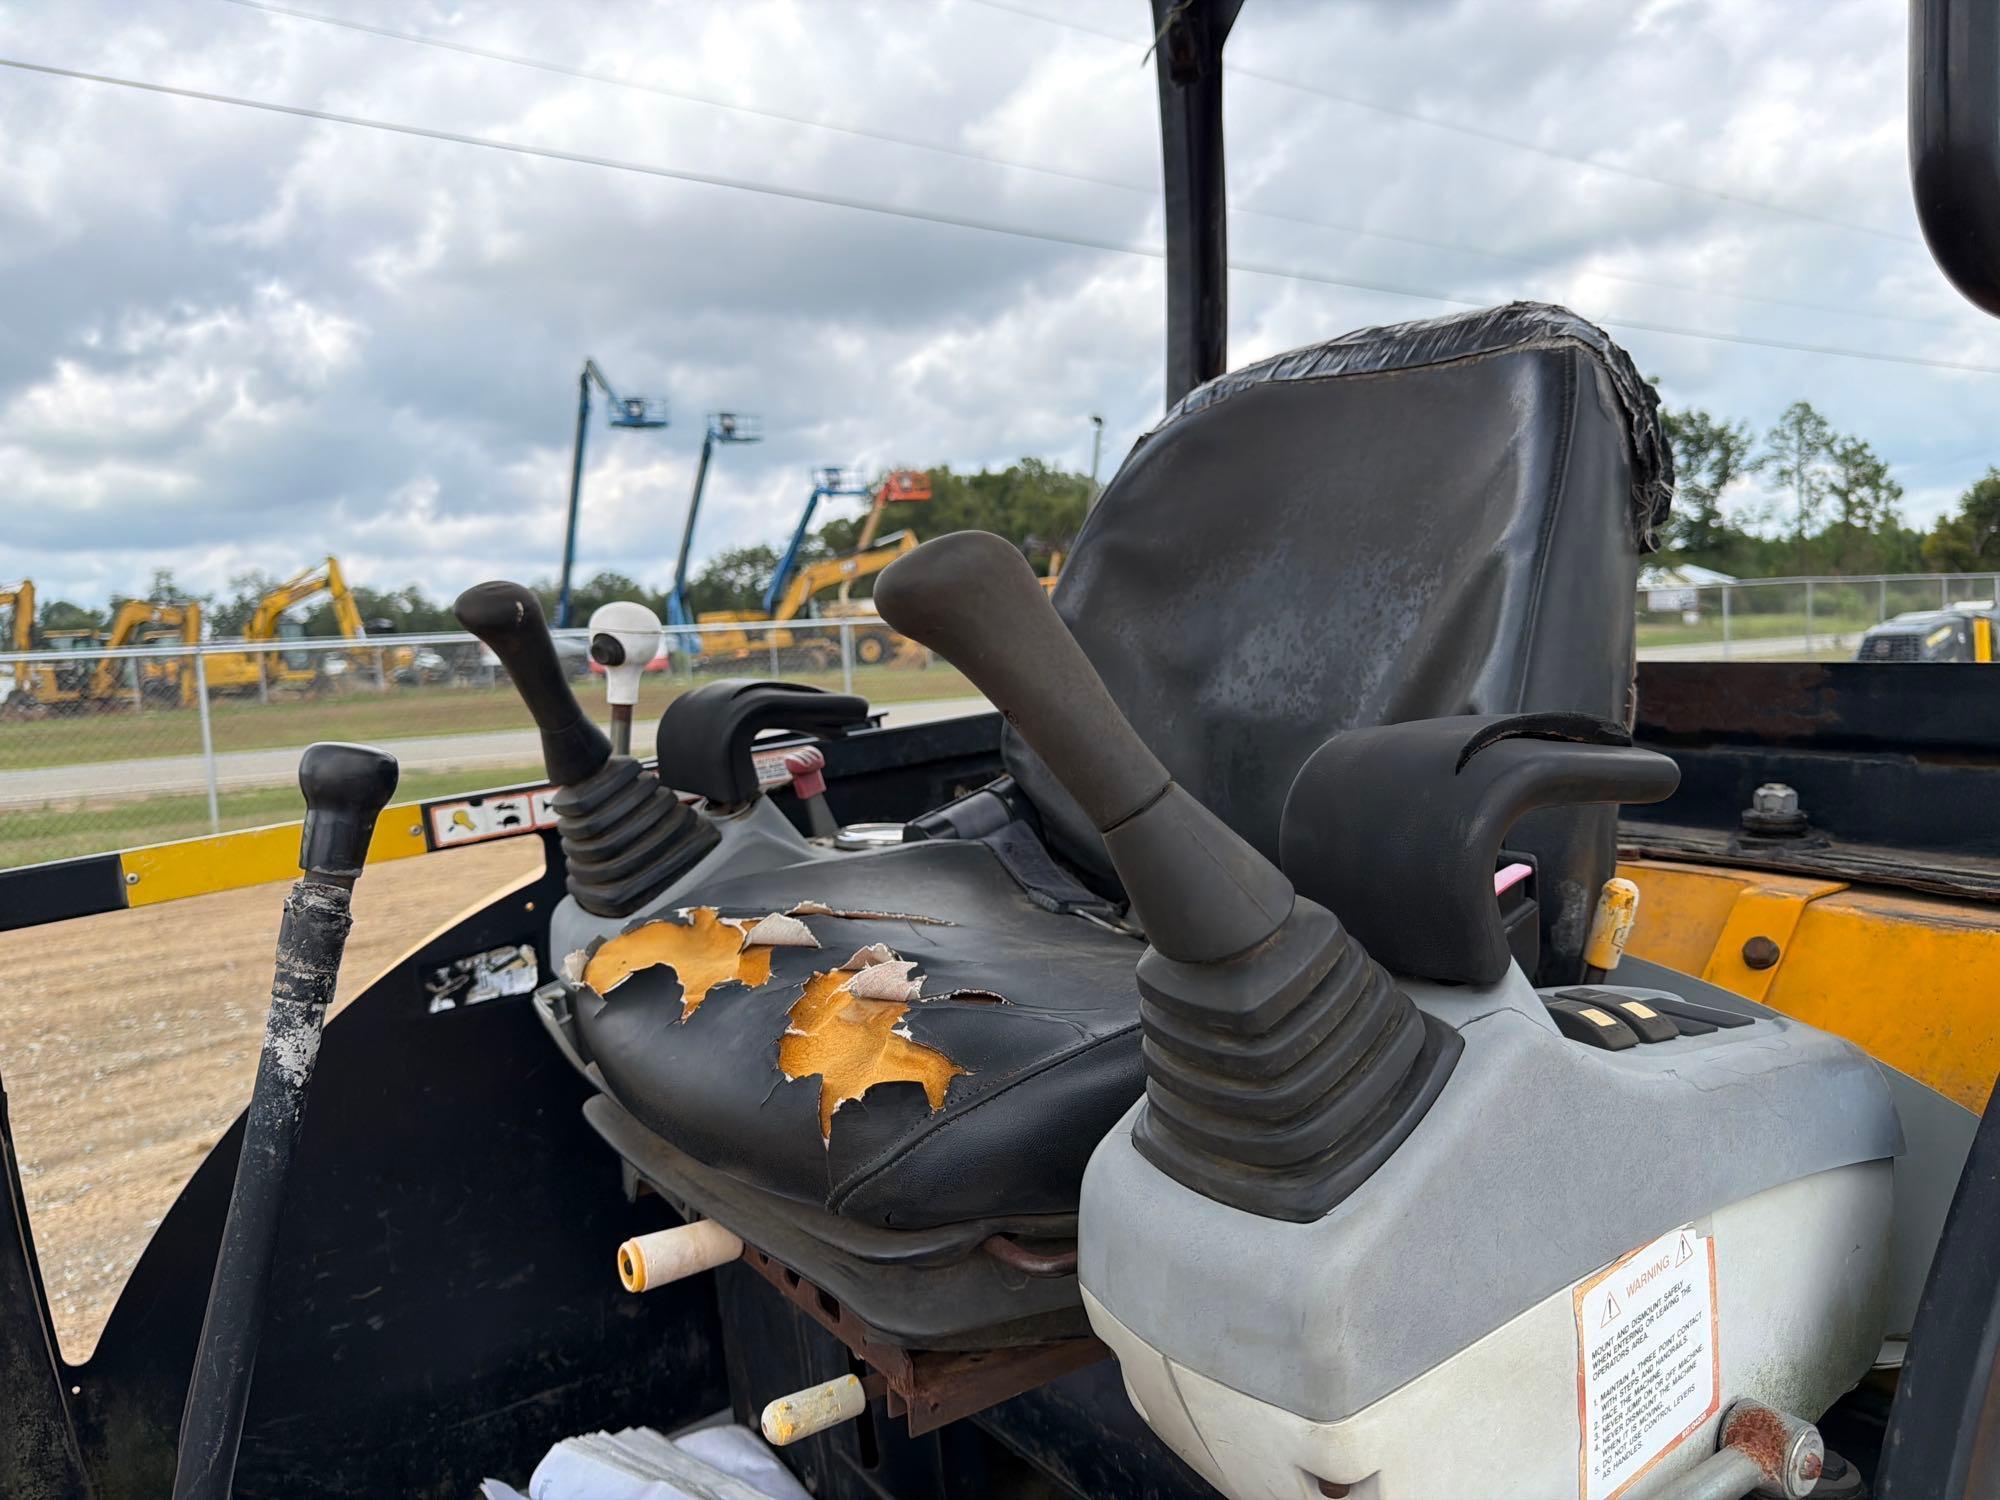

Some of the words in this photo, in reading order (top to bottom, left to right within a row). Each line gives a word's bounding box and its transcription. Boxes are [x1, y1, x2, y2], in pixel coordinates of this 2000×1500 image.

[1626, 1255, 1670, 1298] WARNING
[1592, 1336, 1614, 1360] MOUNT
[1616, 1325, 1630, 1341] AND
[1631, 1298, 1662, 1328] DISMOUNT
[1663, 1280, 1684, 1302] SAFELY
[1592, 1350, 1612, 1370] WHEN
[1613, 1324, 1644, 1354] ENTERING
[1645, 1315, 1655, 1327] OR
[1656, 1295, 1680, 1319] LEAVING
[1681, 1284, 1692, 1299] THE
[1592, 1347, 1630, 1381] OPERATORS
[1600, 1373, 1629, 1401] MAINTAIN
[1637, 1349, 1657, 1370] THREE
[1658, 1333, 1676, 1354] POINT
[1677, 1310, 1702, 1337] CONTACT
[1601, 1394, 1618, 1412] WITH
[1619, 1376, 1639, 1398] STEPS
[1641, 1364, 1654, 1379] AND
[1601, 1405, 1618, 1424] FACE
[1620, 1393, 1632, 1408] THE
[1602, 1412, 1624, 1435] NEVER
[1625, 1396, 1642, 1416] JUMP
[1644, 1388, 1653, 1400] ON
[1655, 1378, 1664, 1390] OR
[1665, 1366, 1676, 1381] OFF
[1602, 1424, 1624, 1446] NEVER
[1625, 1394, 1658, 1427] DISMOUNT
[1659, 1382, 1670, 1397] THE
[1672, 1360, 1697, 1386] MACHINE
[1602, 1456, 1613, 1469] DO
[1614, 1442, 1627, 1459] NOT
[1629, 1430, 1642, 1445] USE
[1643, 1405, 1672, 1433] CONTROL
[1673, 1383, 1696, 1408] LEVERS
[1602, 1437, 1621, 1457] WHEN
[1602, 1467, 1611, 1480] AS
